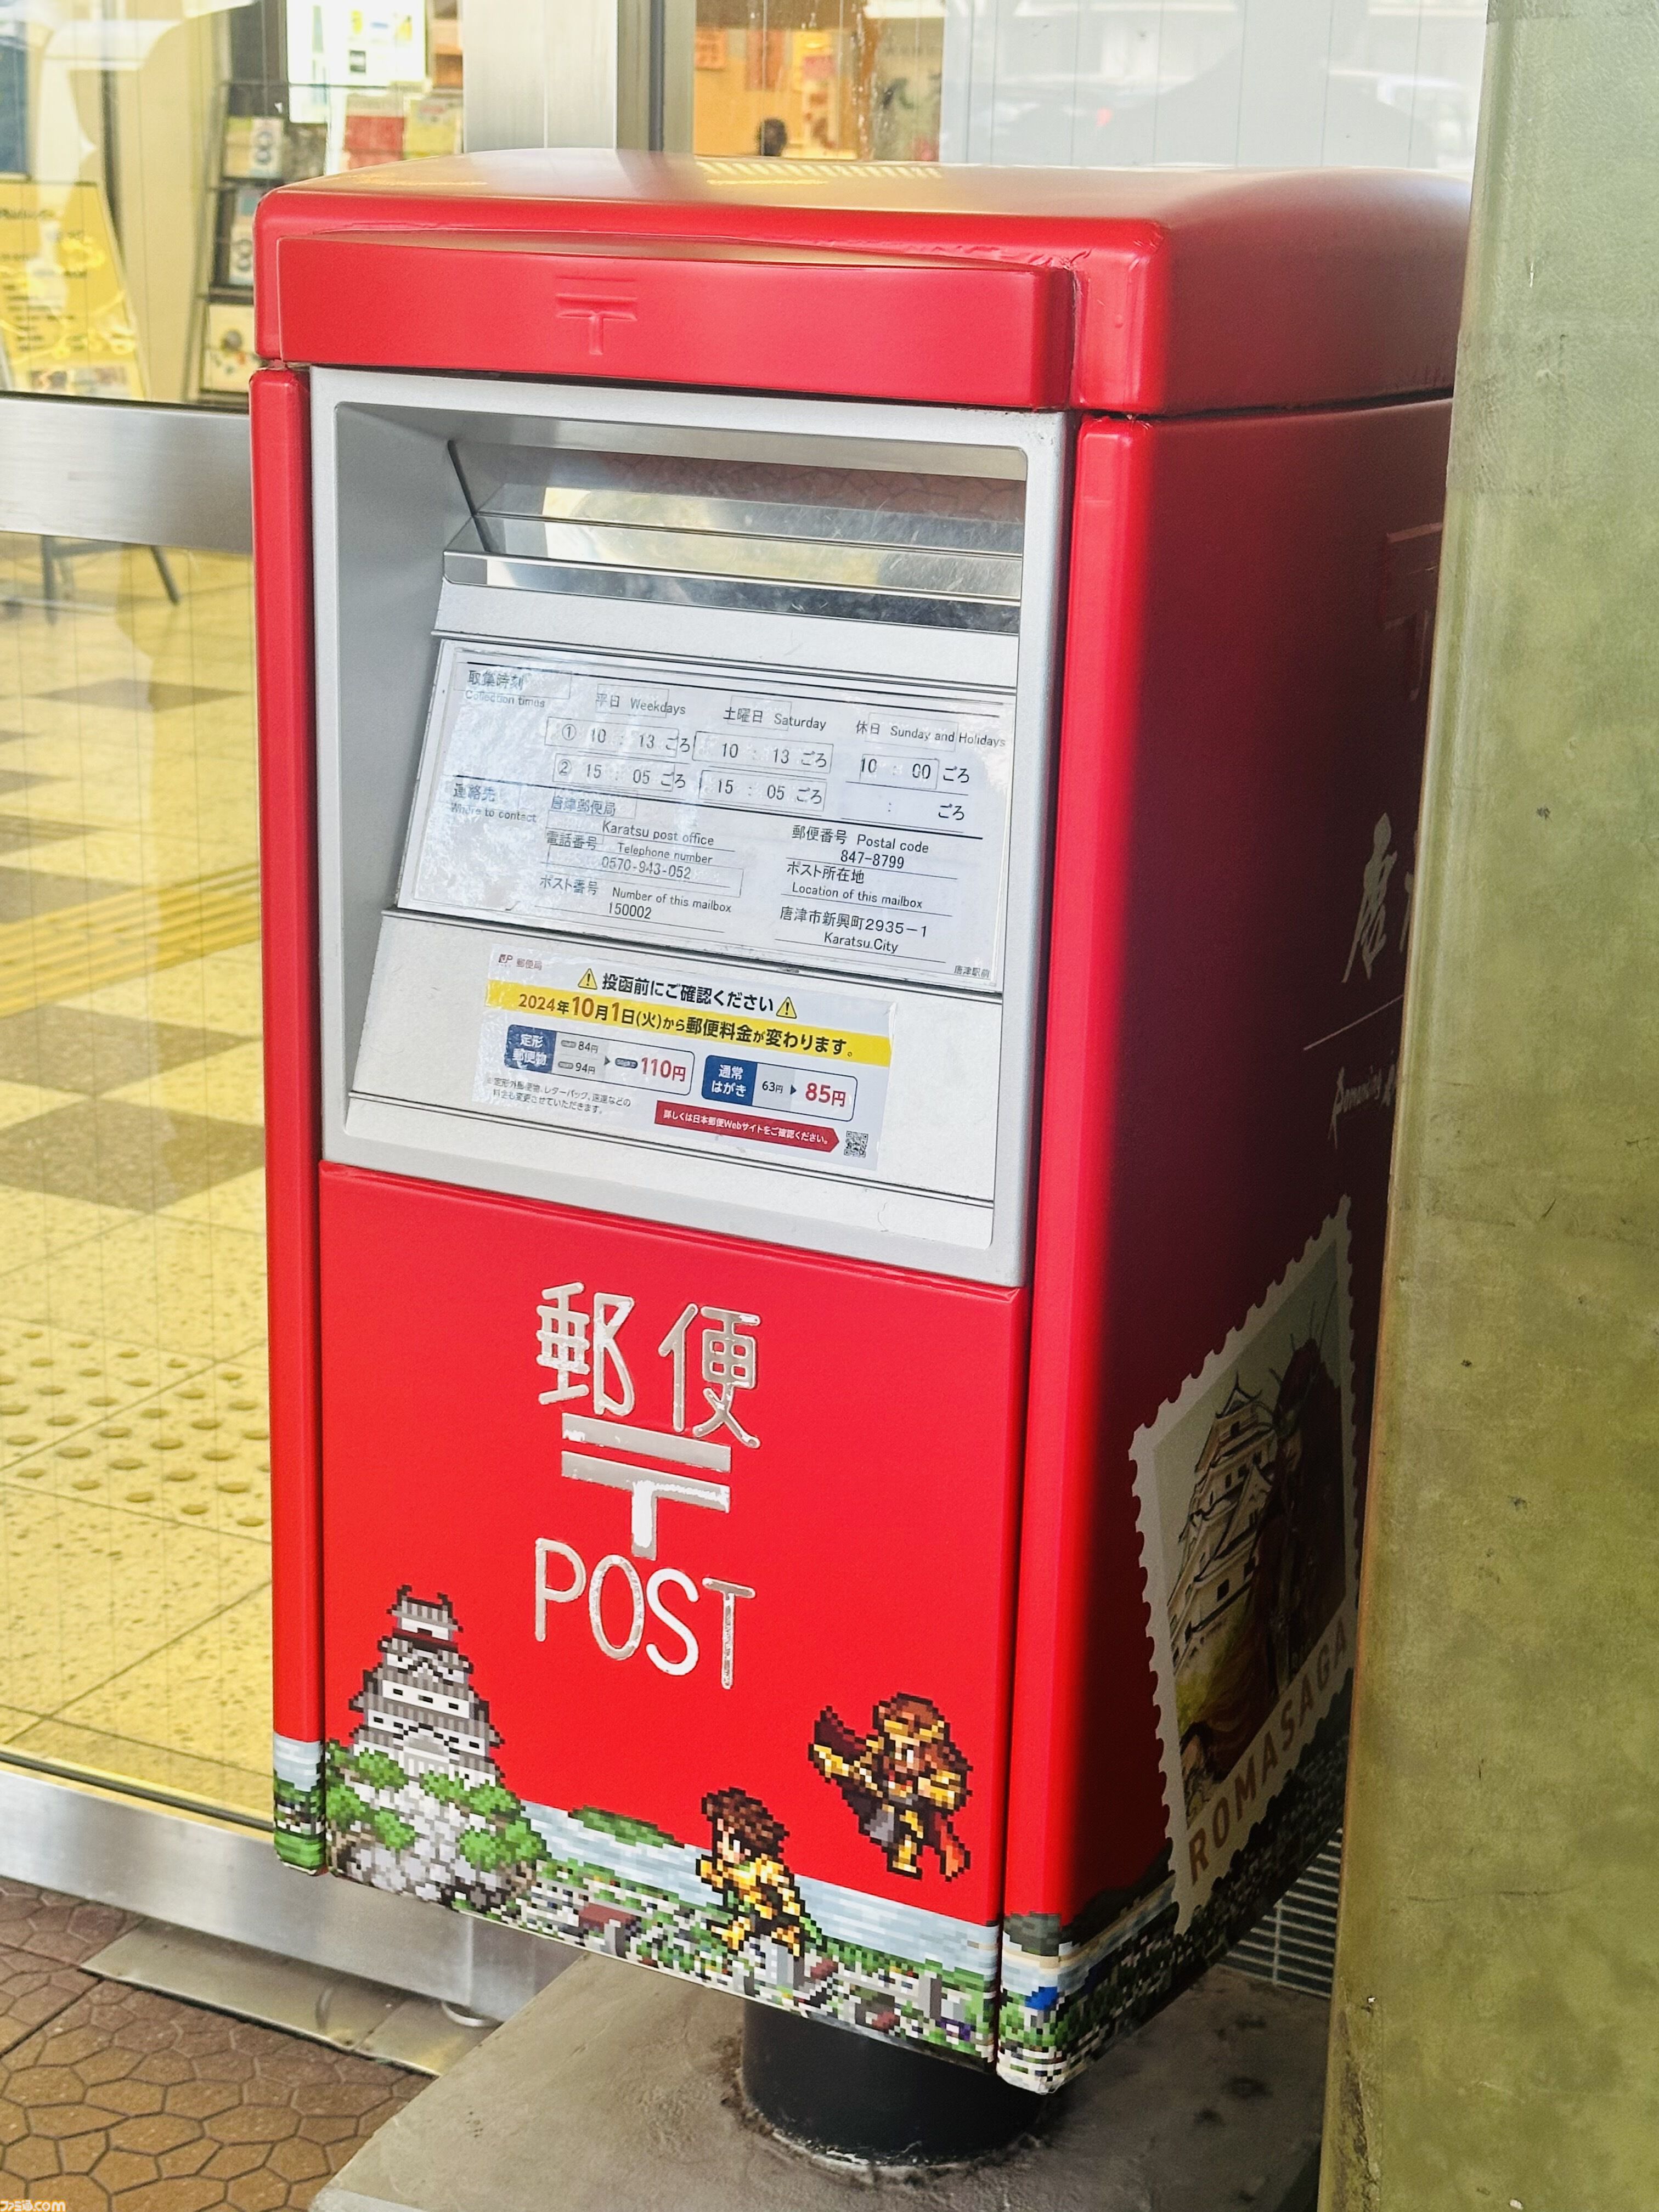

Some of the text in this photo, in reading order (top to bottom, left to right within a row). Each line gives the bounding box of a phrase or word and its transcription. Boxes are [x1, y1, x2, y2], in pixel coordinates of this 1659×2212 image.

[595, 692, 686, 715] 平日 Weekdays
[723, 706, 827, 732] 土曜日 Saturday
[590, 728, 607, 744] 10
[639, 733, 655, 749] 13
[665, 734, 691, 753] ごろ
[856, 719, 1006, 749] 休日 Sunday and Holidays
[721, 743, 828, 769] 10 13 ごろ
[586, 763, 602, 779] 15
[633, 769, 650, 785] 05
[660, 770, 687, 789] ごろ
[860, 757, 970, 784] 10 00 ごろ
[717, 778, 823, 805] 15 05 ごろ
[484, 809, 494, 817] to
[498, 810, 537, 823] contact
[551, 795, 616, 817] 唐津郵便局
[938, 803, 966, 821] ごろ
[602, 820, 714, 847] Karatsu post office
[792, 825, 929, 854] 郵便番号 Postal code
[546, 830, 713, 865] 電話番号 Telephone number
[840, 849, 905, 870] 847-8799
[602, 856, 691, 880] 0570-943-052
[786, 861, 865, 885] ポスト所在地
[540, 874, 732, 913] ポスト番号 Number of this mailbox
[792, 882, 923, 910] Location of this mailbox
[608, 901, 652, 920] 150002
[602, 972, 774, 1012] 投函前にご確認ください
[520, 1033, 544, 1048] 定形
[578, 1041, 599, 1054] 84円
[575, 1062, 596, 1075] 94円
[641, 1057, 686, 1082] 110円
[718, 1064, 744, 1080] 通常
[711, 1080, 747, 1098] はがき
[762, 1081, 783, 1094] 63円
[805, 1082, 847, 1107] 85円
[536, 1281, 760, 1448] 郵便
[534, 1537, 756, 1690] POST
[1189, 1619, 1347, 1886] ROMASAGA
